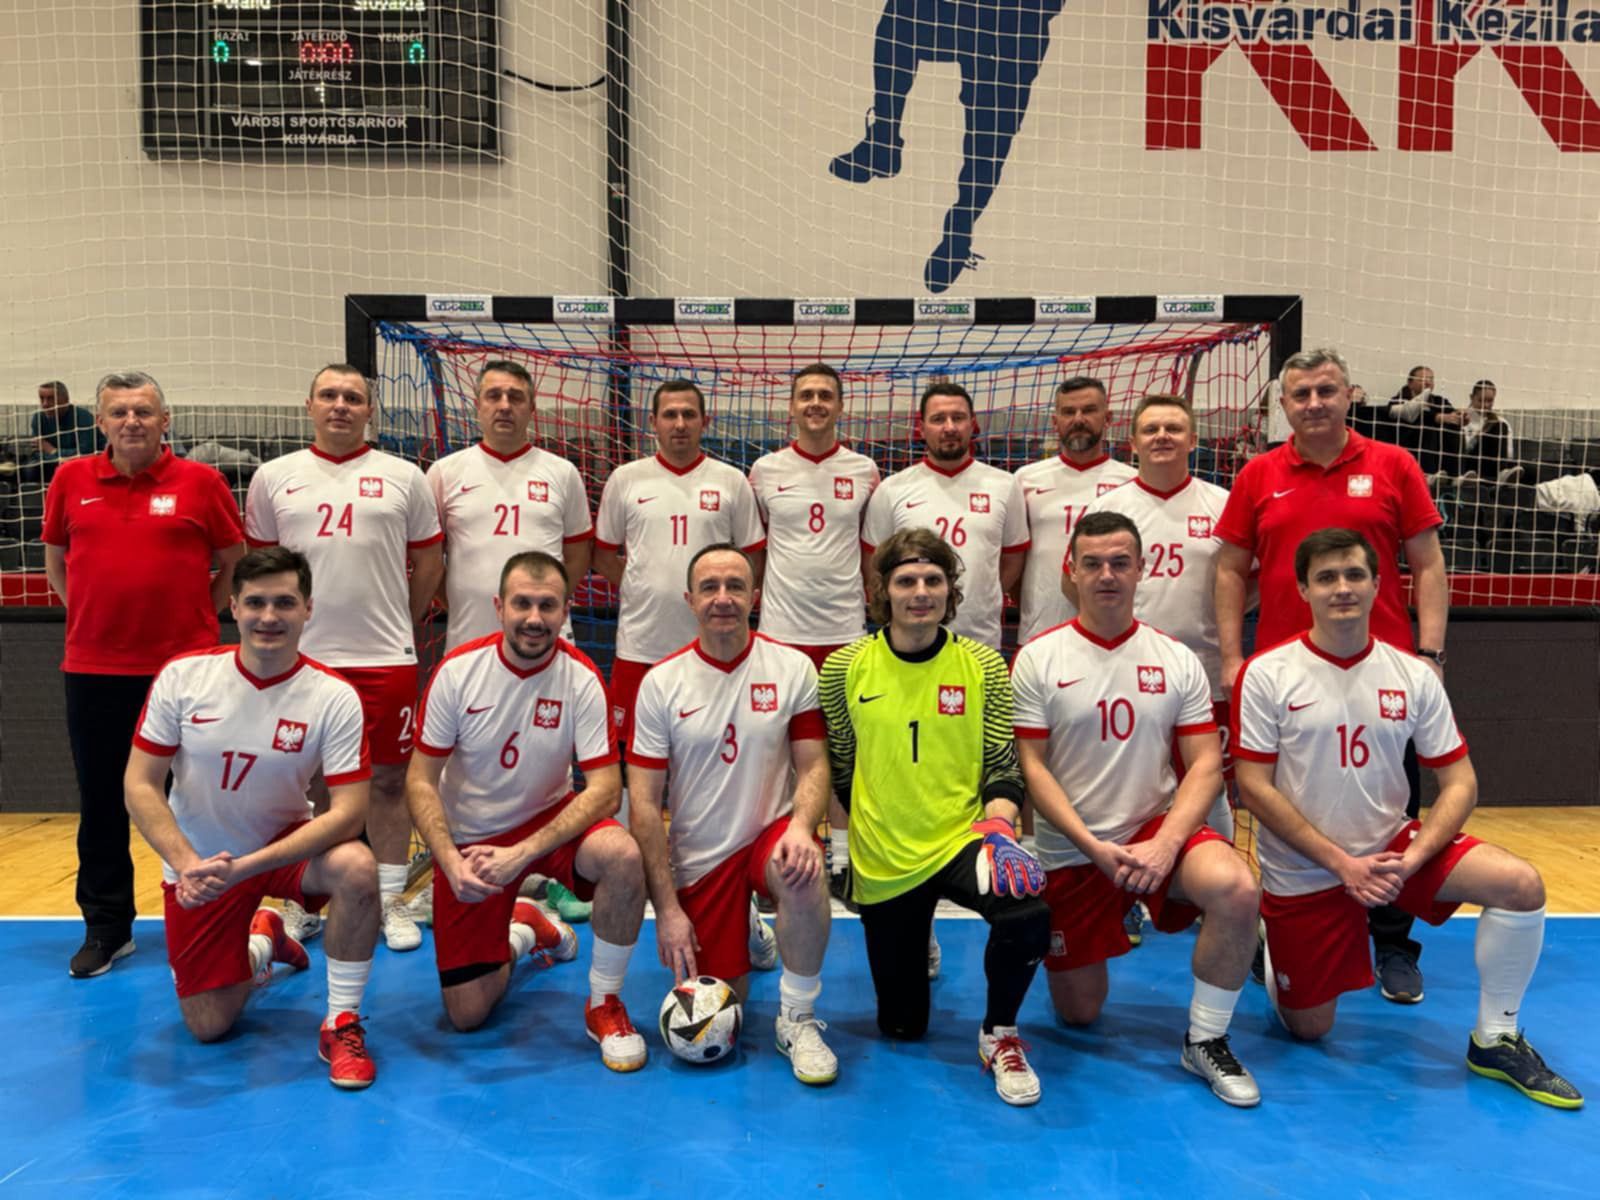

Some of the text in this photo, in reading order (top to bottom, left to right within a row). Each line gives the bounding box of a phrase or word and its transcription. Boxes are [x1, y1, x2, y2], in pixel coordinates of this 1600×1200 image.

[1147, 0, 1412, 41] Kisvárdai
[288, 67, 352, 81] JÁTÉKRÉSZ
[231, 115, 408, 129] VÁROSI SPORTCSARNOK
[283, 133, 358, 145] KISVÁRDA
[316, 502, 354, 538] 24
[493, 503, 520, 537] 21
[670, 514, 688, 546] 11
[807, 502, 826, 534] 8
[935, 516, 967, 548] 26
[1149, 542, 1185, 578] 25
[398, 706, 417, 741] 2
[1096, 697, 1136, 742] 10
[499, 731, 519, 770] 6
[720, 722, 739, 765] 3
[908, 720, 920, 764] 1
[1336, 723, 1370, 769] 16
[220, 750, 258, 791] 17
